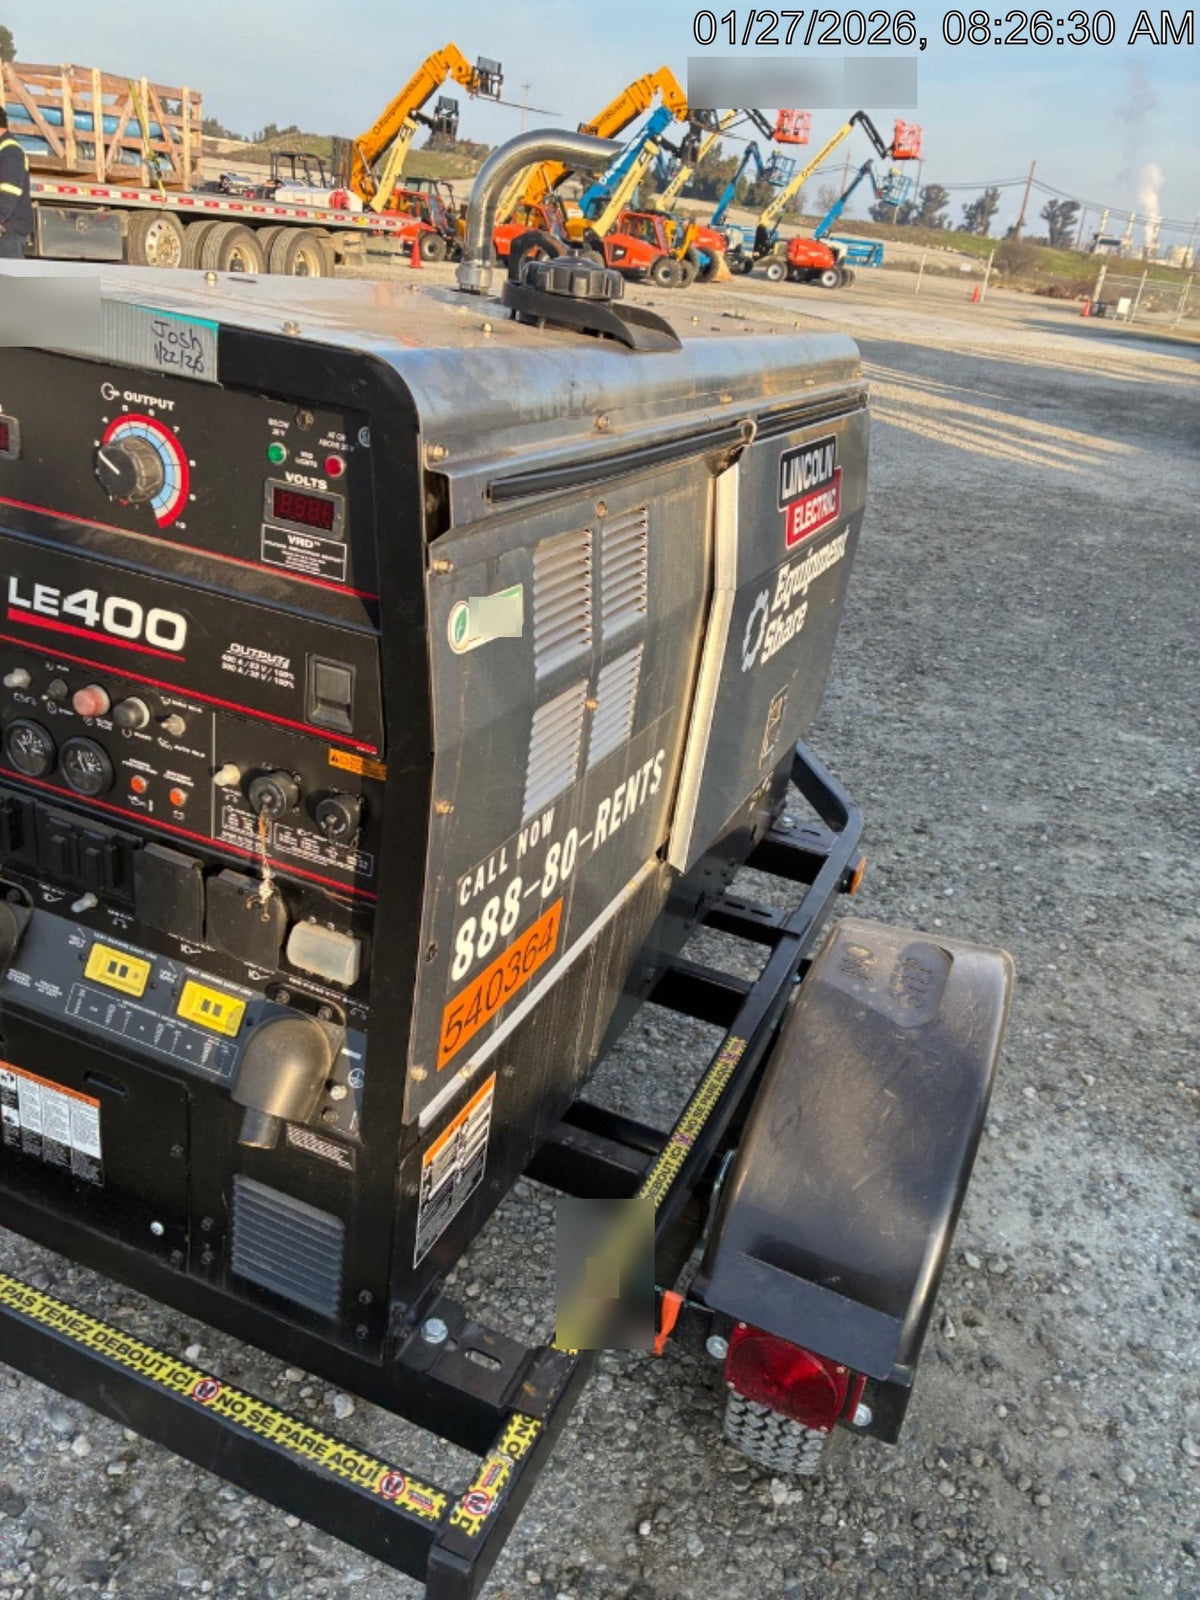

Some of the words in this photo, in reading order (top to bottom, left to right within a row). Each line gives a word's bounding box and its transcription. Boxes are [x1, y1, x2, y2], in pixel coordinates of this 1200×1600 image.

[150, 319, 203, 354] Josh
[123, 390, 176, 411] OUTPUT
[284, 471, 328, 490] VOLTS
[781, 443, 835, 501] LINCOLN
[287, 534, 315, 549] VRD
[792, 487, 837, 536] ELECTRIC
[771, 524, 850, 613] Equipment
[8, 575, 188, 652] LE400
[761, 601, 808, 666] Share
[450, 749, 667, 983] 888-80-RENTS
[459, 846, 509, 907] CALL
[516, 806, 556, 860] NOW
[442, 917, 556, 1053] 540364
[1, 1284, 38, 1308] PAS
[38, 1302, 94, 1337] TENEZ
[91, 1332, 167, 1375] DEBOUT
[165, 1365, 196, 1388] ICI
[214, 1392, 248, 1415] NO
[247, 1409, 277, 1429] SE
[274, 1423, 330, 1457] PARE
